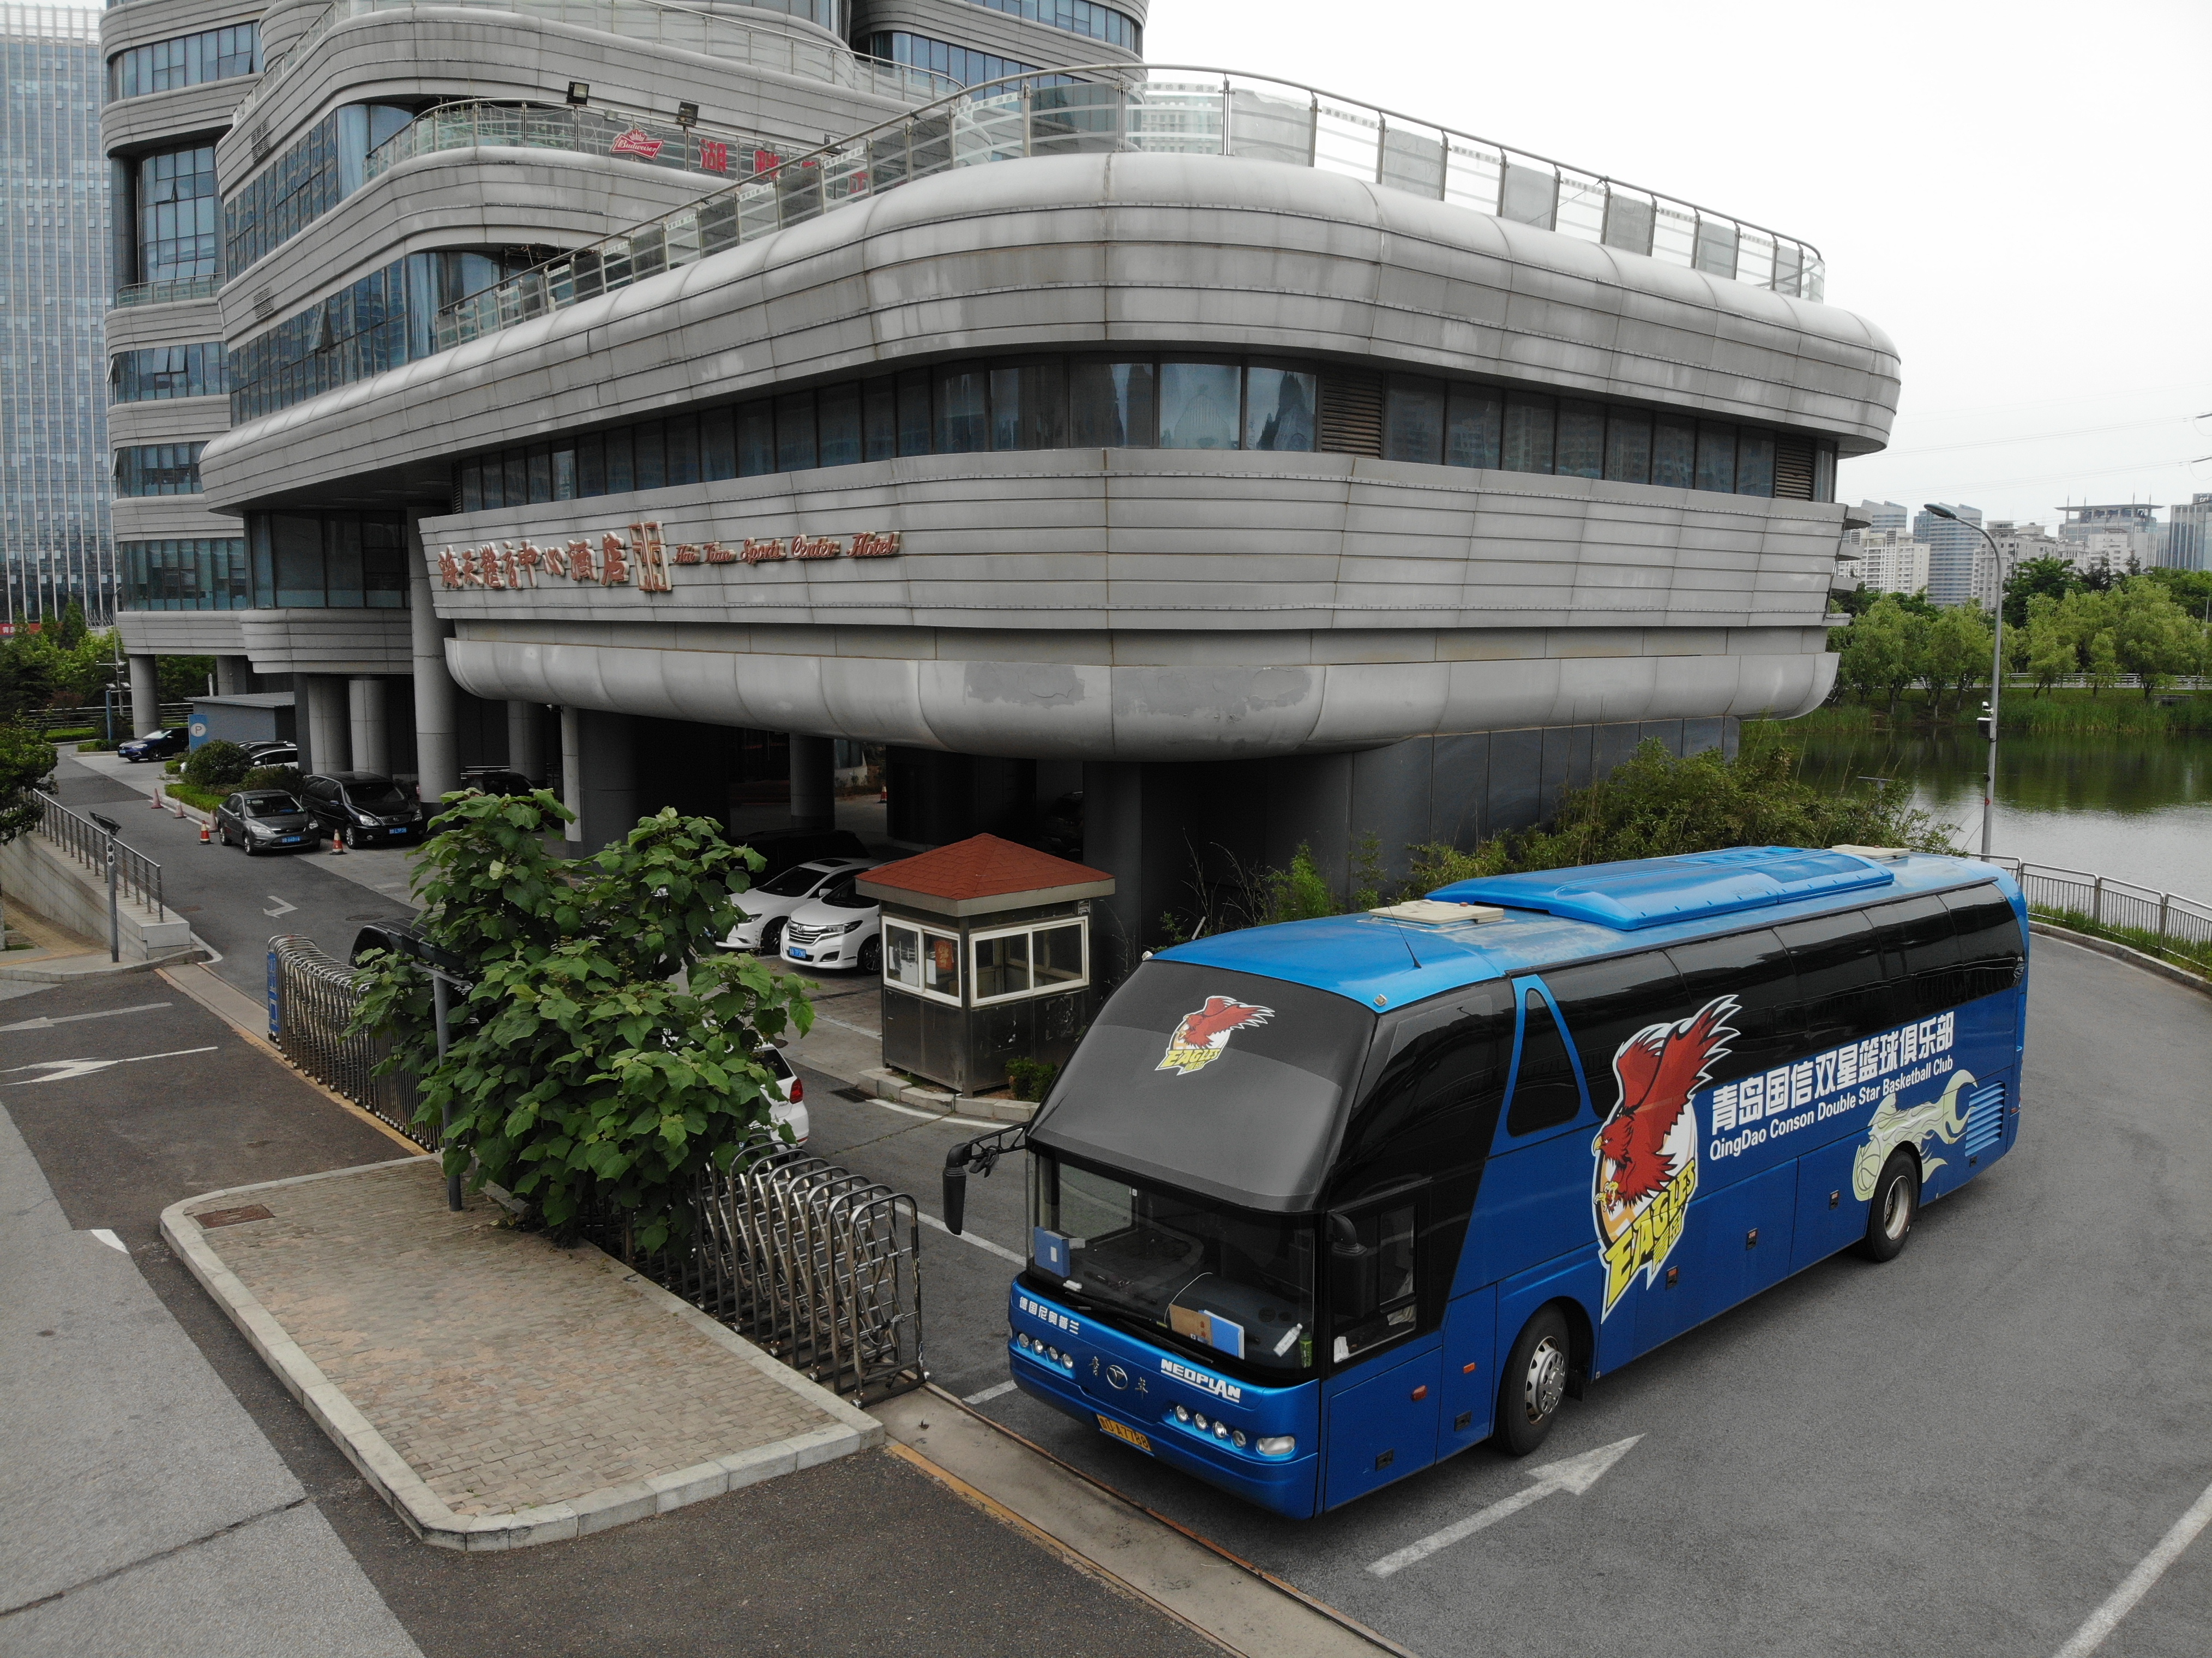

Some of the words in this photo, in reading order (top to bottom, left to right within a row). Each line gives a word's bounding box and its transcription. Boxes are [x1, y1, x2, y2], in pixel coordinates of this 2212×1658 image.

[616, 140, 657, 152] Budweiser
[672, 544, 700, 563] Hai
[703, 542, 735, 563] Tian
[740, 537, 786, 564] Sports
[791, 534, 840, 557] Center
[846, 532, 899, 557] Hotel
[1159, 1049, 1221, 1068] EAGLES
[1711, 1011, 1954, 1135] 青岛国信双星篮球俱乐部
[1710, 1128, 1766, 1161] QingDao
[1770, 1109, 1814, 1138] Conson
[1817, 1095, 1855, 1120] Double
[1858, 1085, 1880, 1104] Star
[1883, 1065, 1931, 1096] Basketball
[1933, 1055, 1953, 1072] Club
[1604, 1159, 1696, 1309] EAGLES
[1019, 1296, 1079, 1335] 德国尼奥普兰
[1161, 1358, 1241, 1403] NEOPLAN
